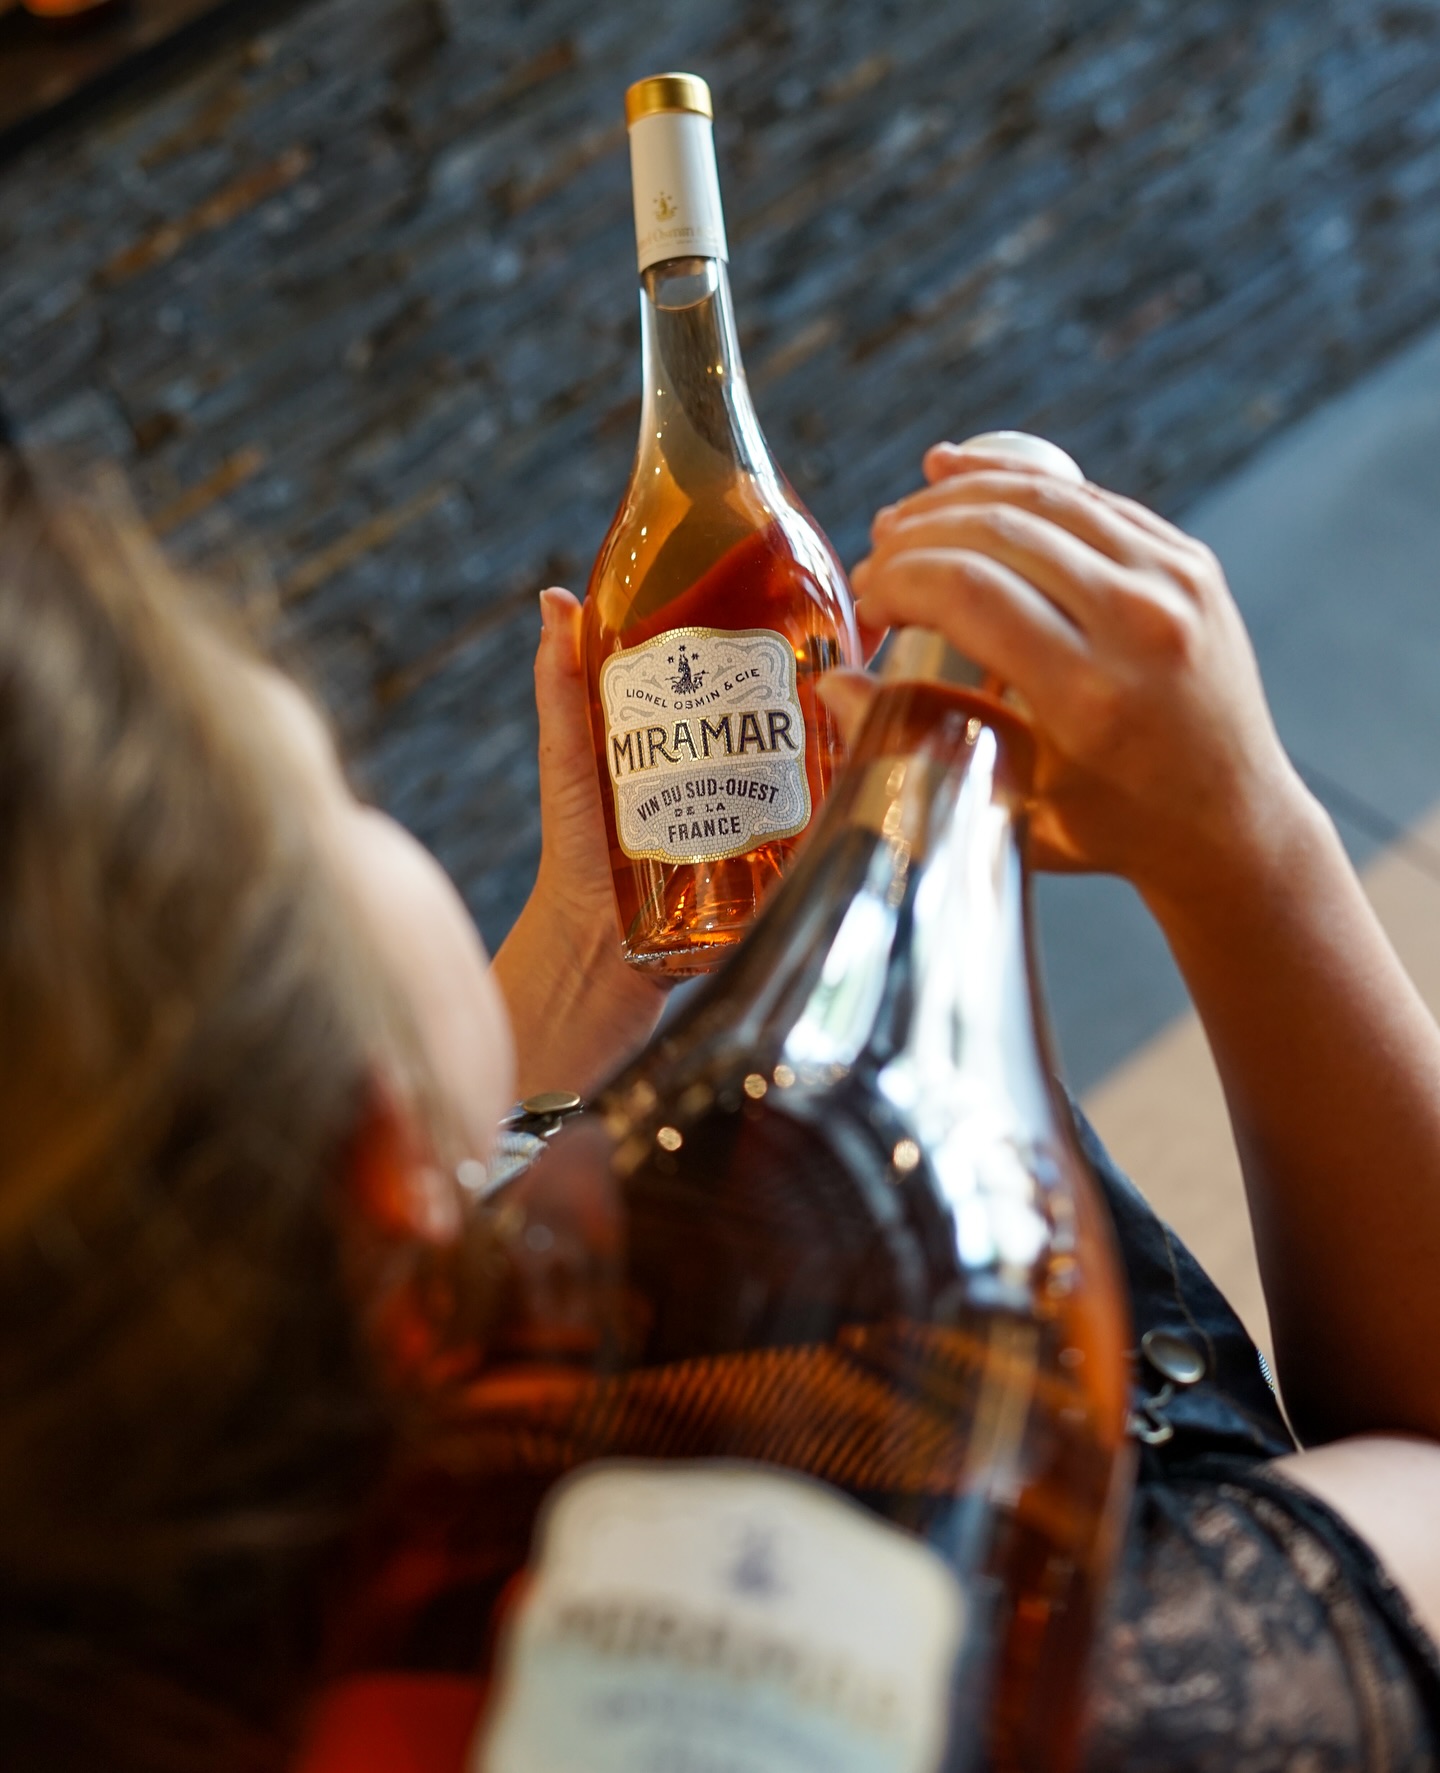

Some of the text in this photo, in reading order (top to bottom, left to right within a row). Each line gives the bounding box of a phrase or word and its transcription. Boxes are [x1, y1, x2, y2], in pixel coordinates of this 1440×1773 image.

[626, 668, 760, 711] LIONEL OSMIN & CIE
[611, 709, 798, 778] MIRAMAR
[637, 777, 780, 822] VIN DU SUD-OUEST
[674, 802, 726, 818] DE LA
[668, 816, 742, 844] FRANCE
